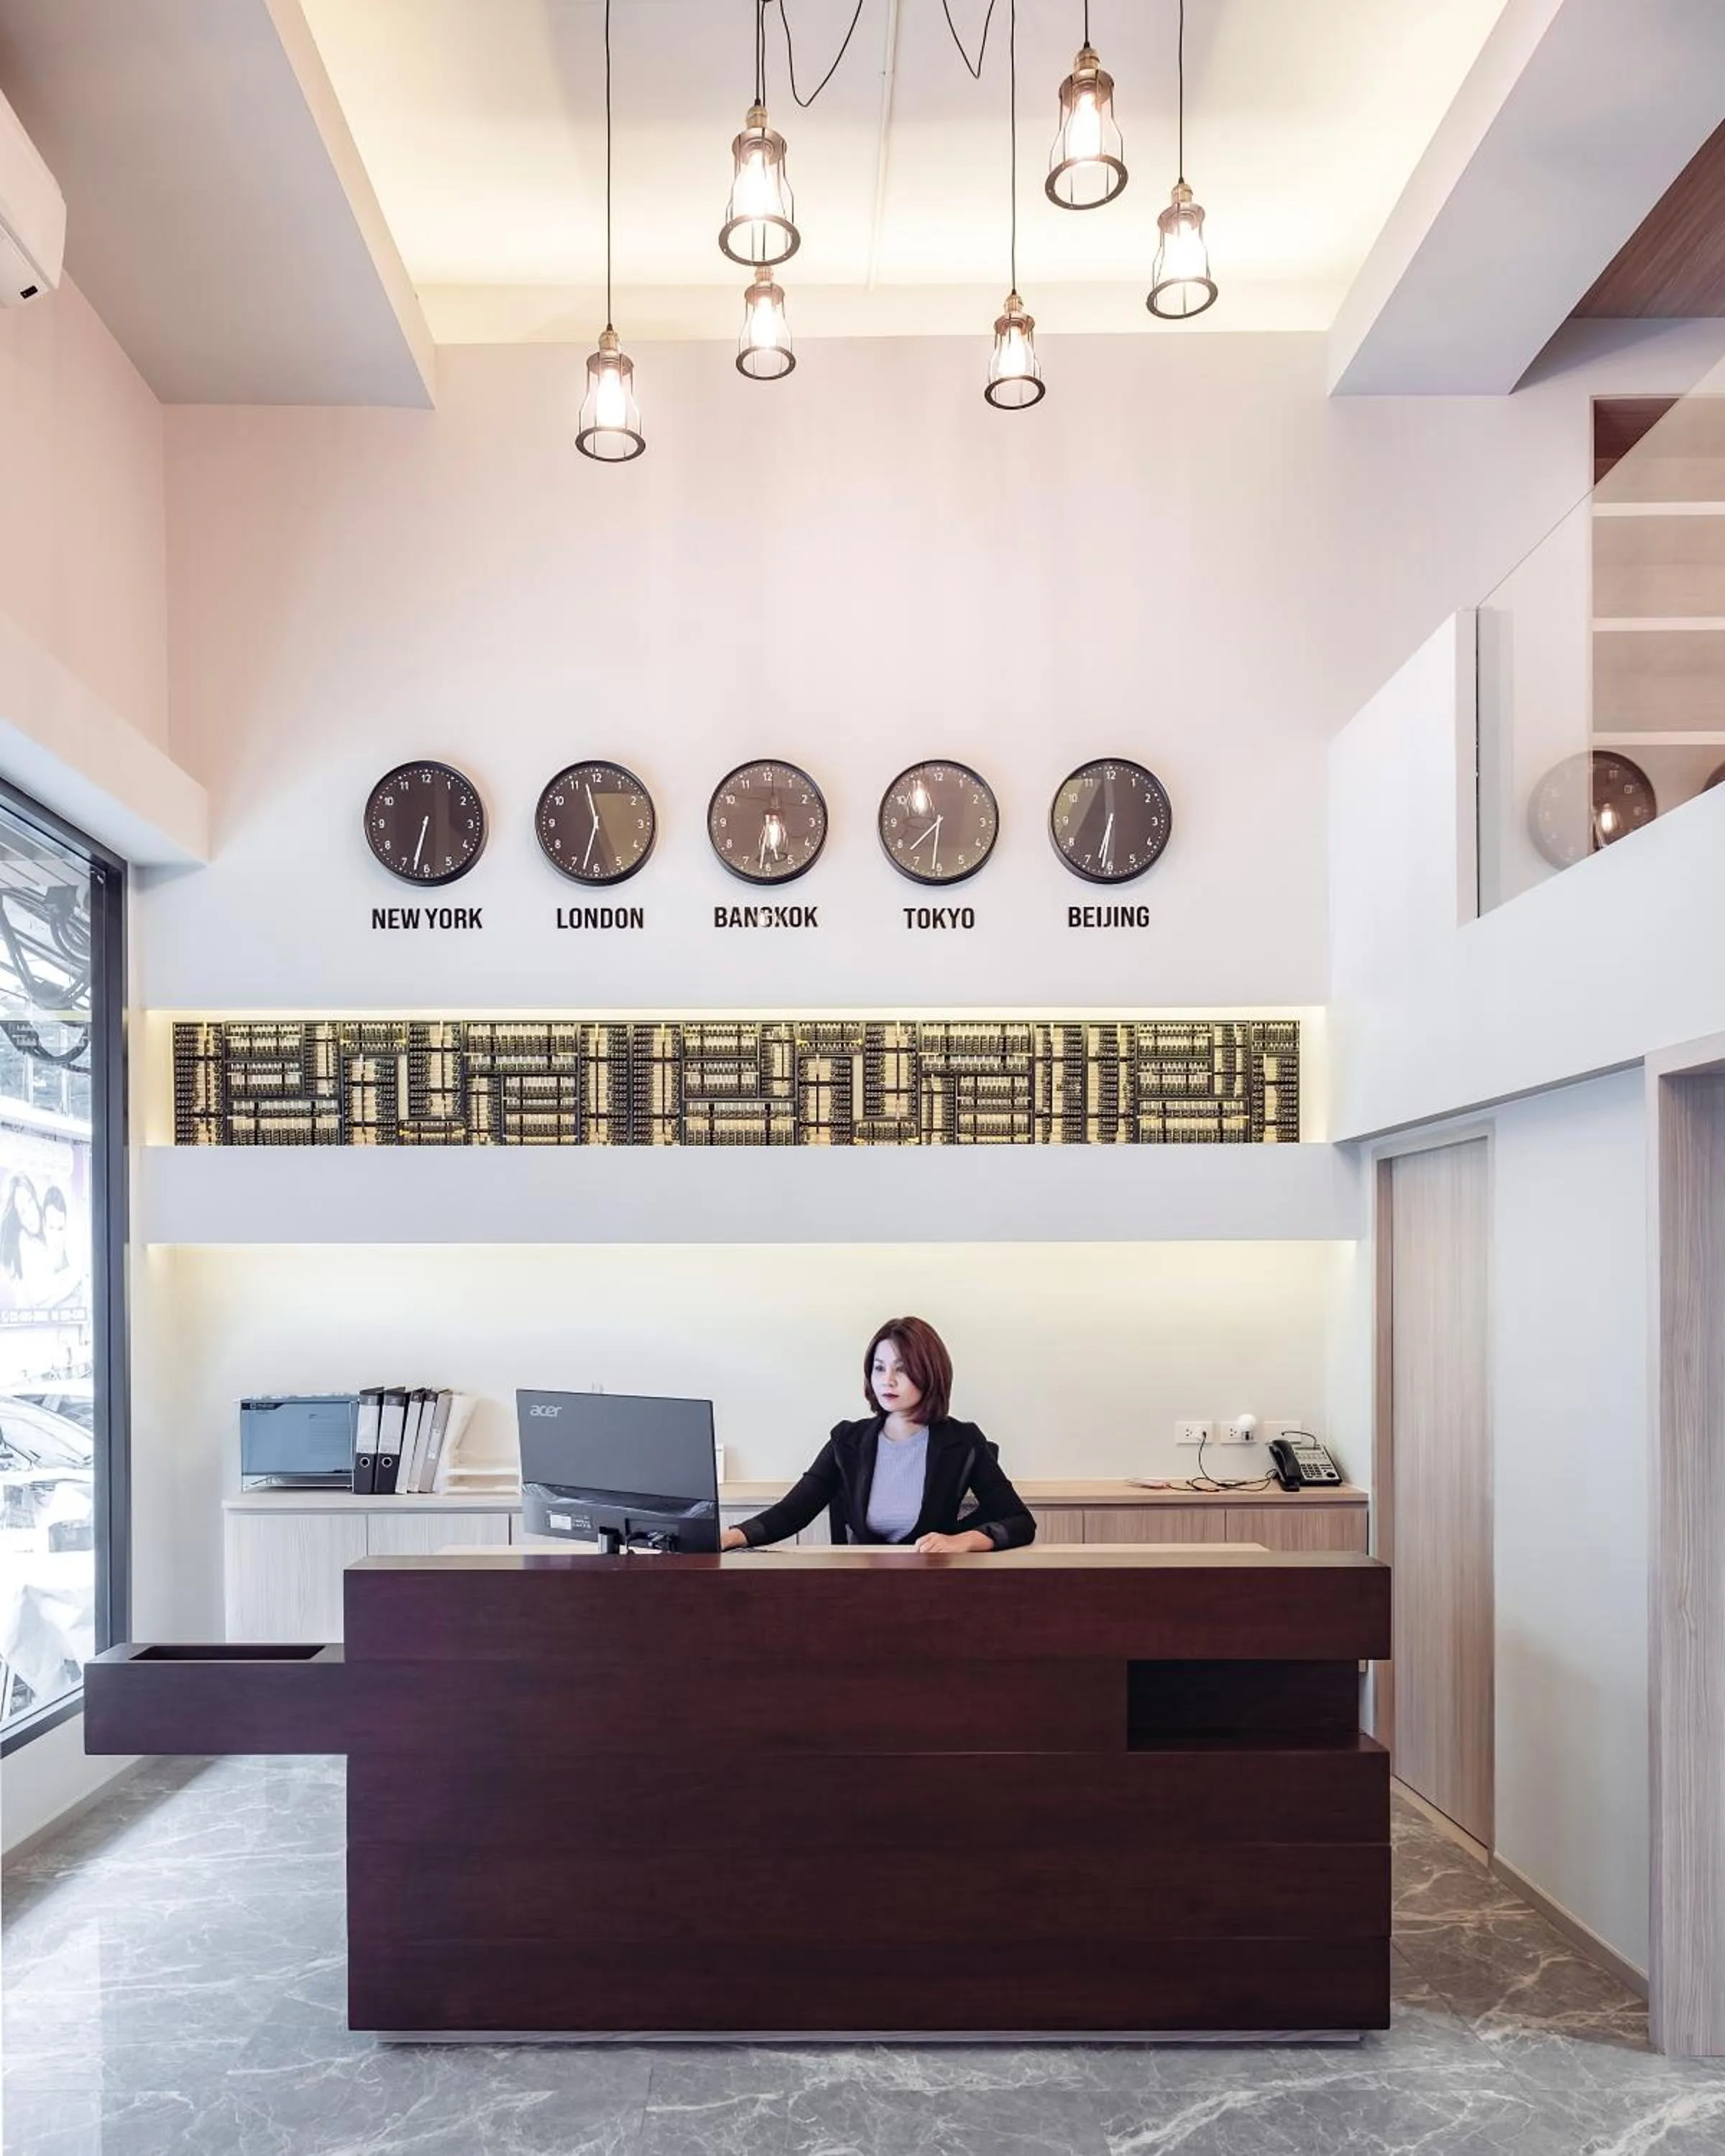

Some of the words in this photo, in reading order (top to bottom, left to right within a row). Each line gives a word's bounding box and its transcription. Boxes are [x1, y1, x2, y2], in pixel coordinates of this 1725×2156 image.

[555, 796, 564, 805] 10
[631, 796, 636, 805] 2
[726, 796, 735, 804] 10
[801, 795, 807, 803] 2
[973, 795, 978, 803] 2
[1069, 793, 1077, 802] 10
[380, 819, 385, 828] 9
[468, 819, 473, 828] 3
[638, 819, 643, 828] 3
[720, 818, 726, 826] 9
[809, 818, 815, 826] 3
[980, 818, 985, 826] 3
[1063, 816, 1068, 825] 9
[1151, 817, 1158, 826] 3
[385, 841, 390, 849] 8
[555, 839, 561, 848] 8
[727, 839, 732, 848] 8
[446, 857, 451, 865] 5
[571, 857, 576, 865] 7
[616, 857, 621, 865] 5
[788, 855, 793, 864] 5
[959, 855, 964, 864] 5
[594, 864, 599, 872] 6
[372, 908, 420, 929] NEW
[424, 908, 483, 929] YORK
[557, 908, 643, 929] LONDON
[903, 908, 975, 929] TOKYO
[1068, 906, 1149, 928] BEIJING
[530, 1405, 562, 1417] acer
